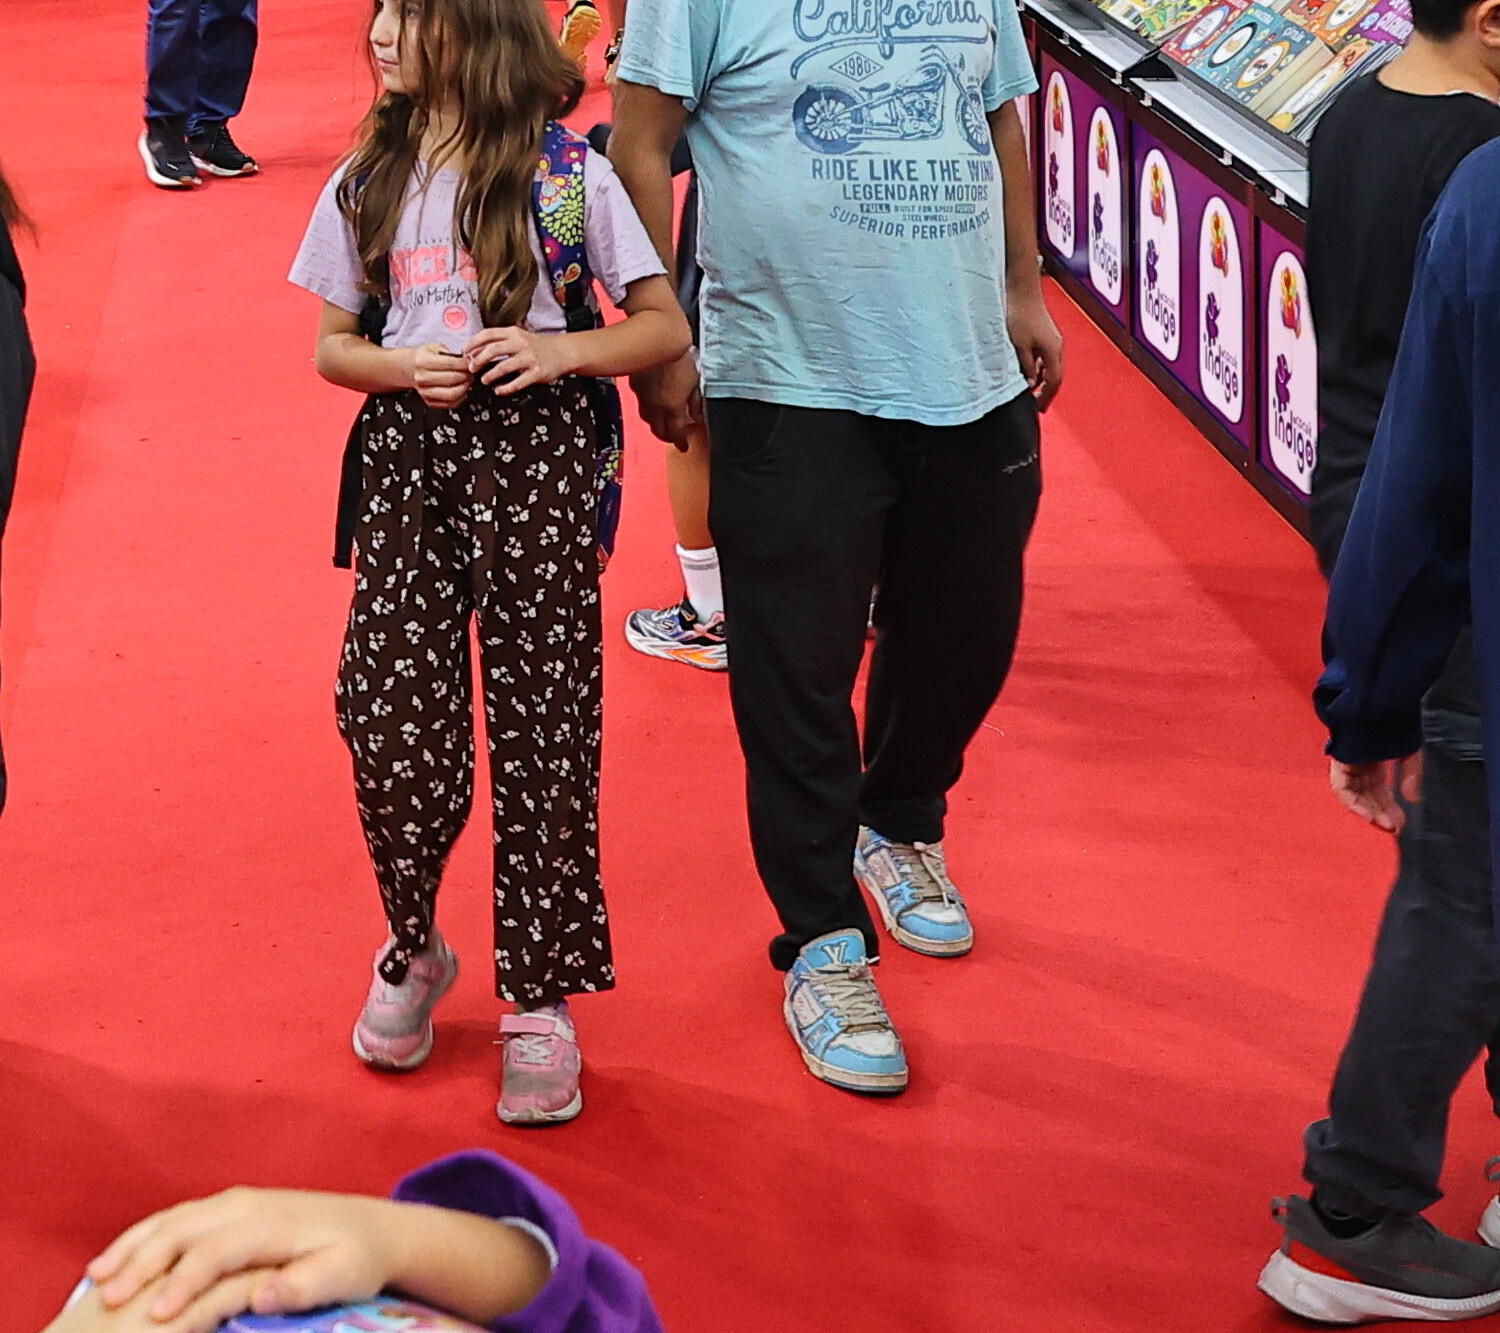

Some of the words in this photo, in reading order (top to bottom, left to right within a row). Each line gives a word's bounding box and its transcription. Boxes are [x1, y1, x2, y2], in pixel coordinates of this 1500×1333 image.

[842, 56, 873, 76] 1980
[811, 158, 857, 182] RIDE
[868, 158, 907, 182] LIKE
[917, 158, 962, 183] THE
[842, 183, 941, 202] LEGENDARY
[944, 182, 990, 202] MOTORS
[829, 205, 907, 237] SUPERIOR
[913, 208, 993, 239] PERFORMANCE
[1143, 277, 1176, 343] indigo
[1202, 332, 1239, 403] indigo
[1273, 397, 1315, 474] indigo
